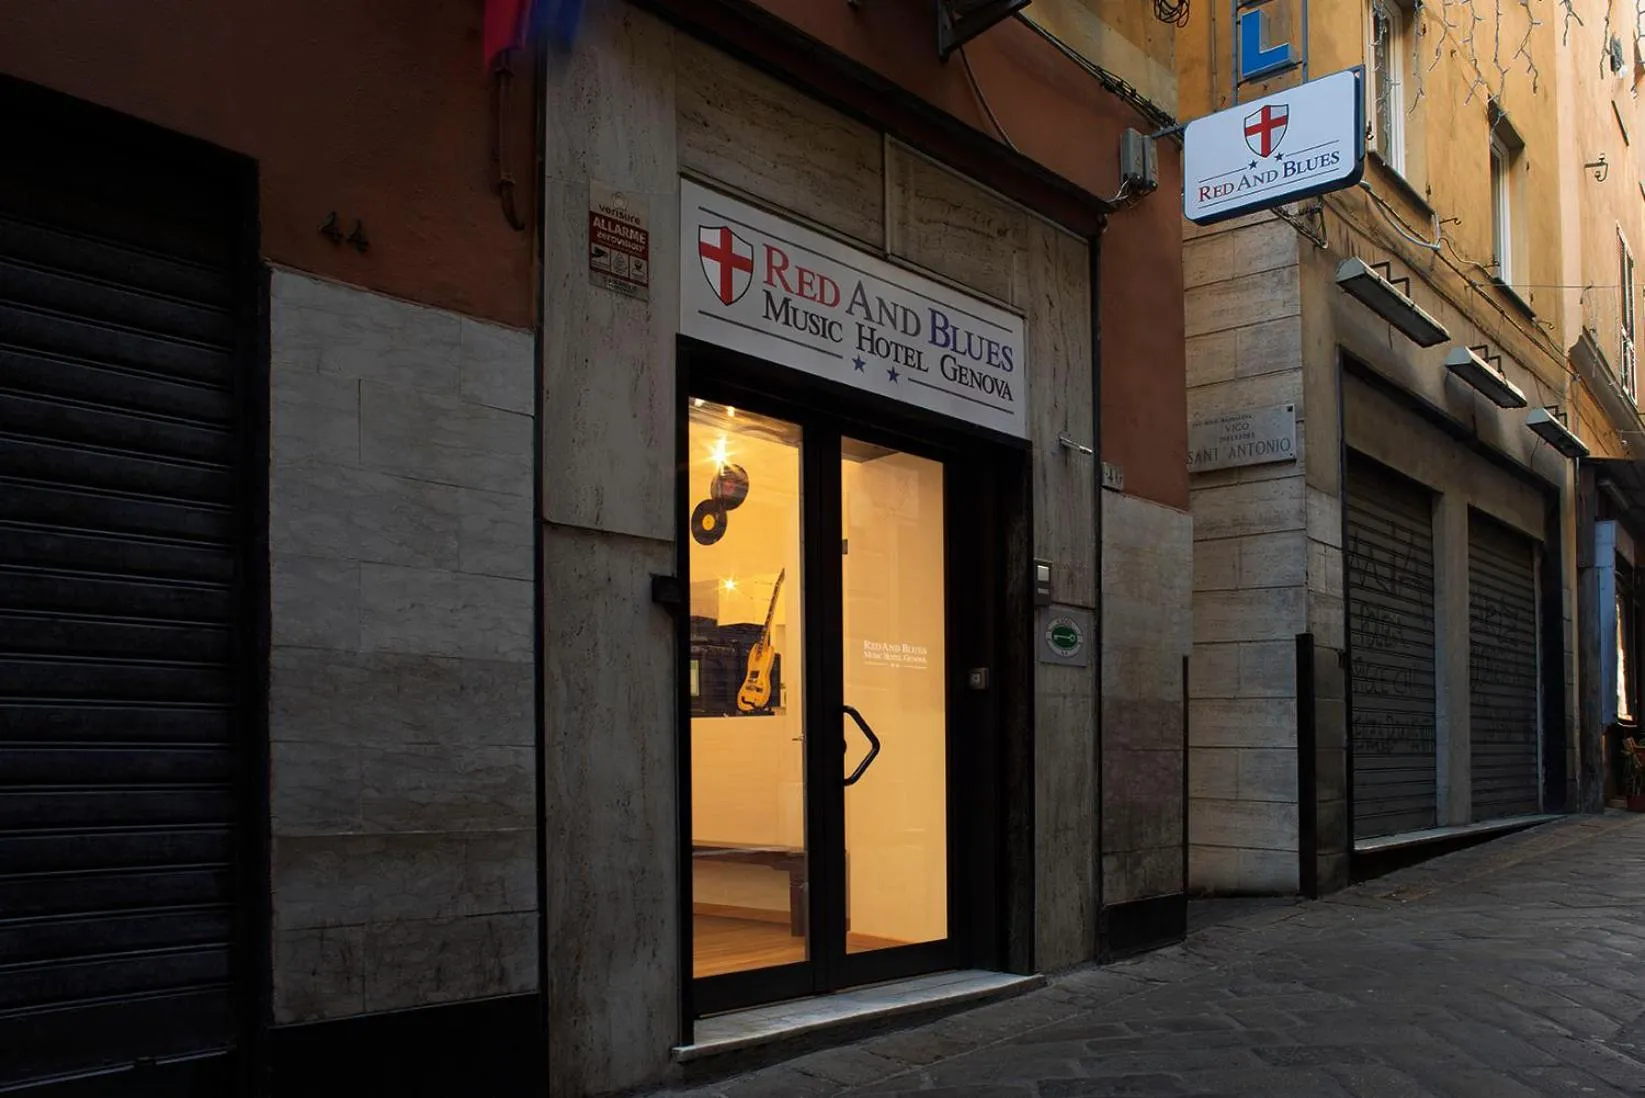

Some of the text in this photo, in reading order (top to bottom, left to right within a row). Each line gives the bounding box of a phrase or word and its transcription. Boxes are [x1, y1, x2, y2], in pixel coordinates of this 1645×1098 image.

[1241, 9, 1290, 77] L
[1199, 151, 1340, 202] RED AND BLUES
[317, 210, 370, 253] 44
[593, 216, 646, 244] ALLARME
[762, 243, 1014, 373] RED AND BLUES
[763, 290, 1014, 402] MUSIC HOTEL GENOVA
[1228, 437, 1291, 460] ANTONIO
